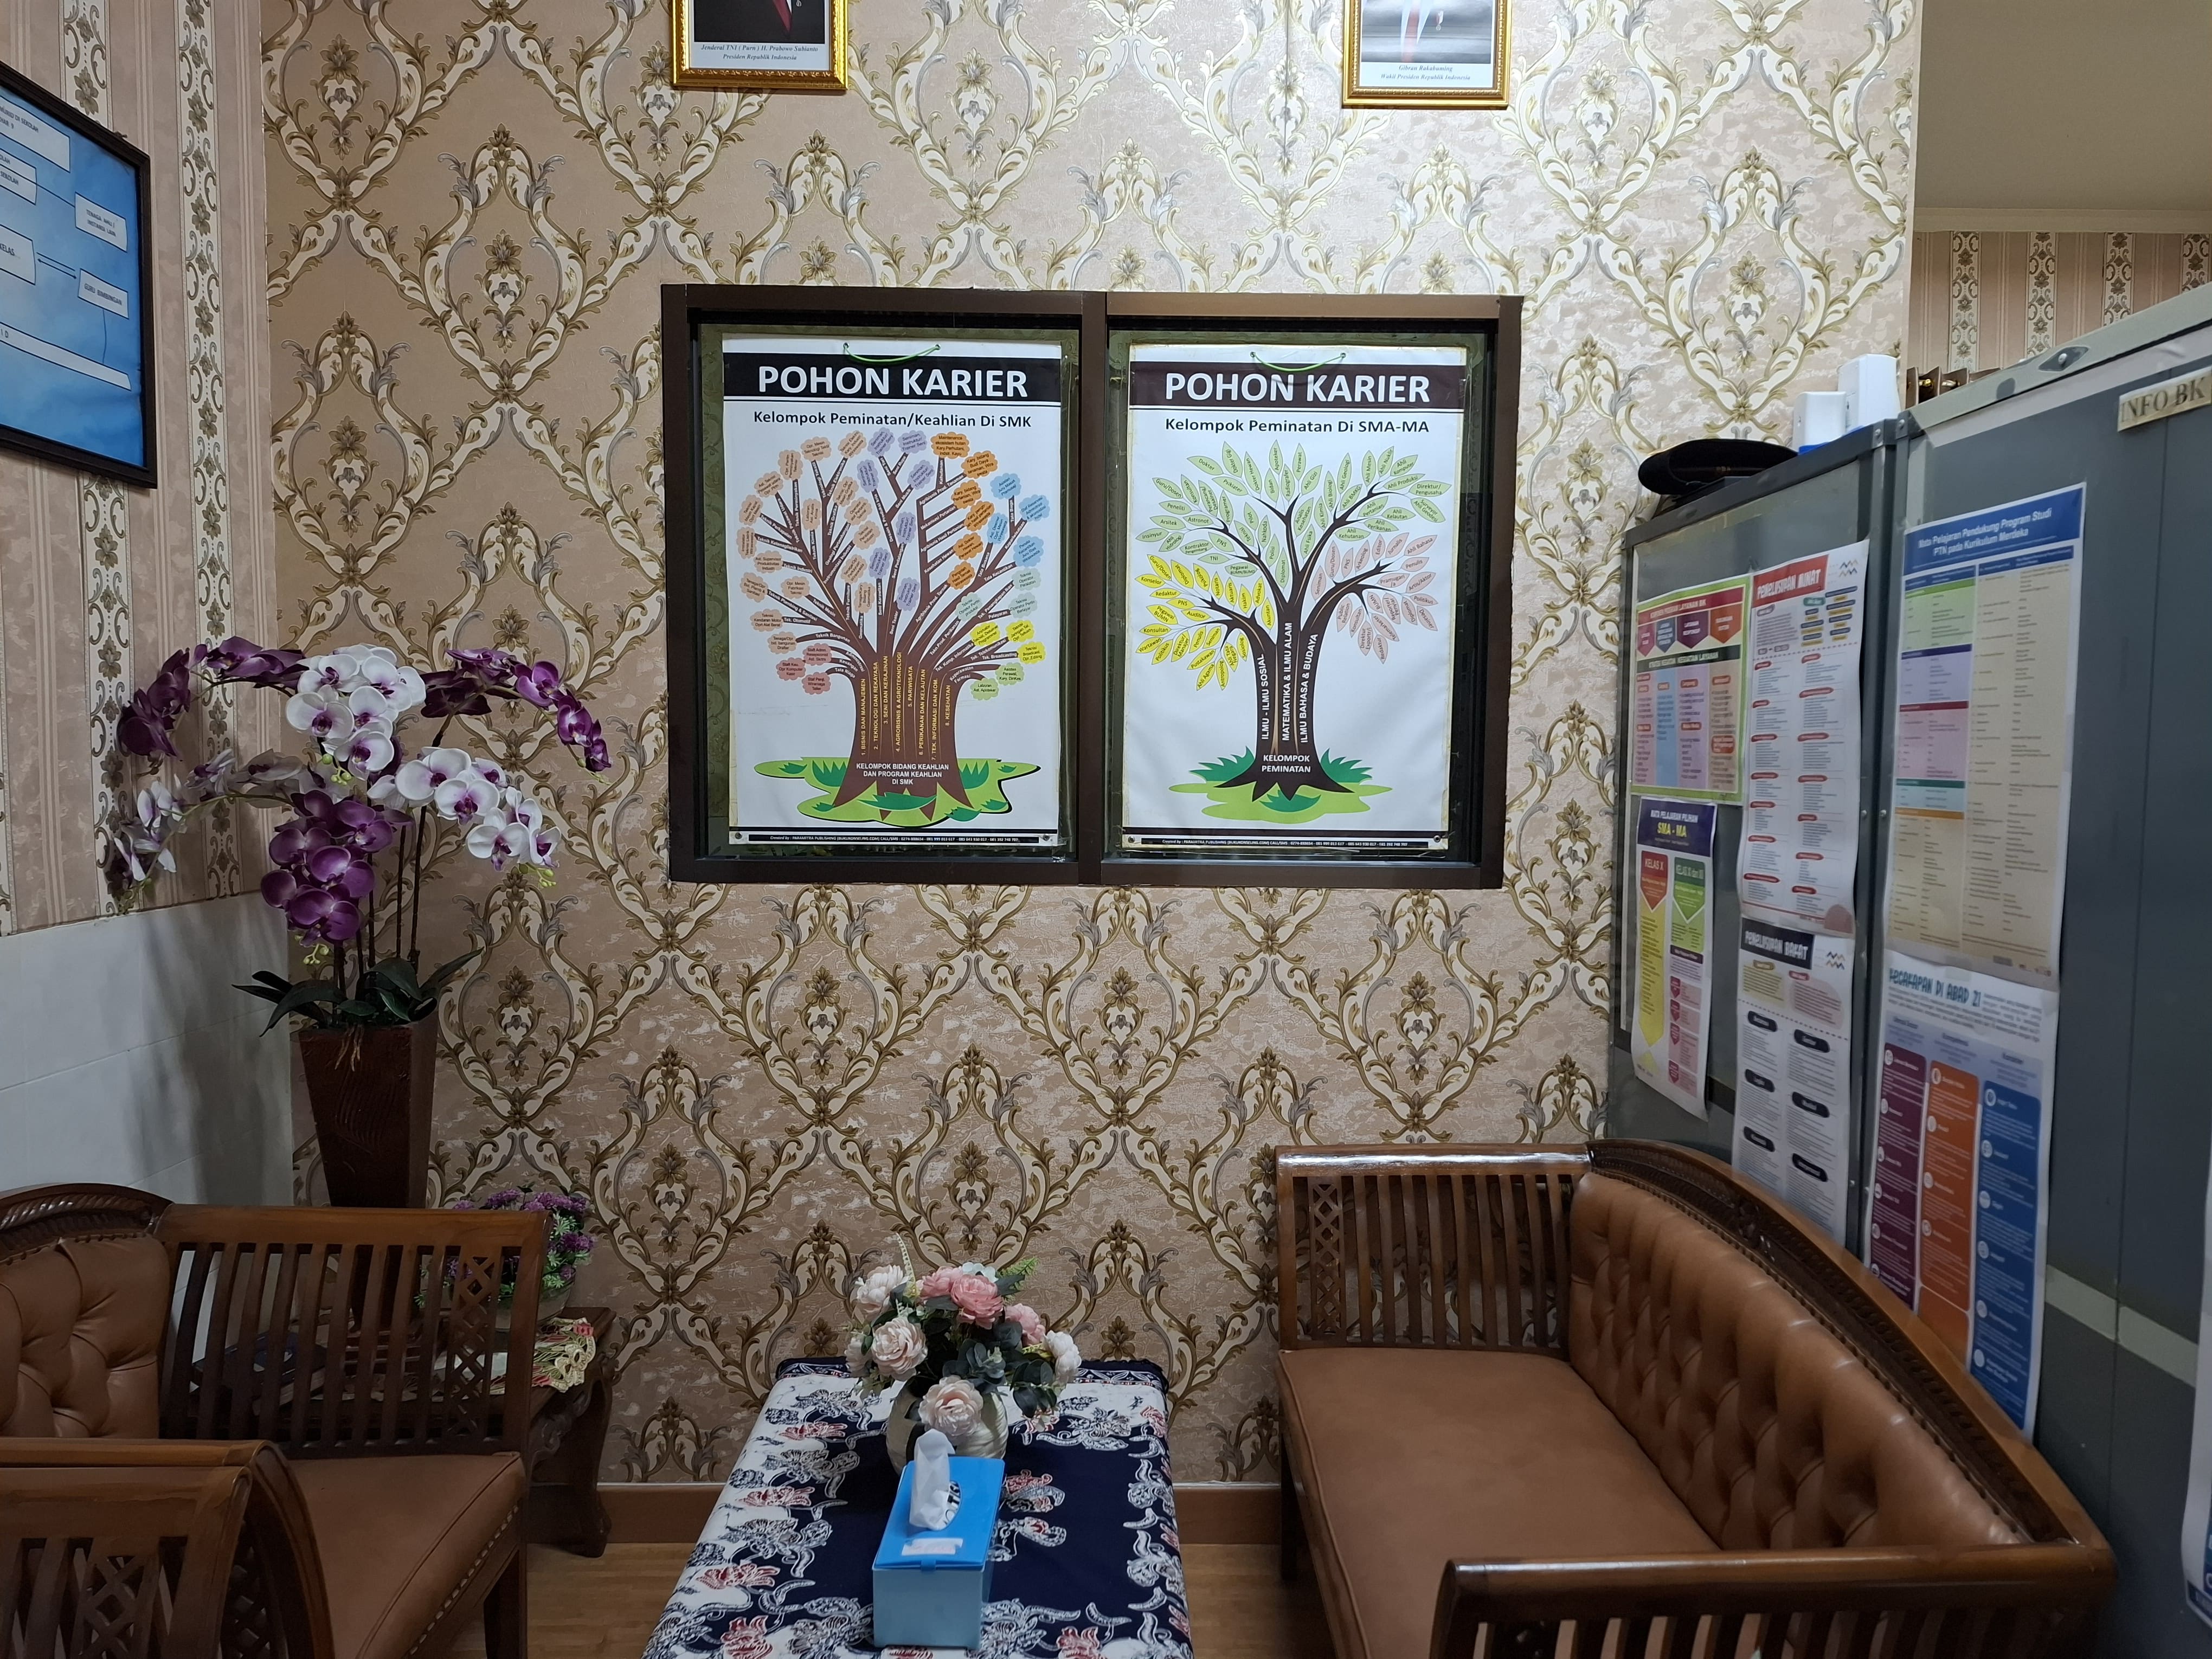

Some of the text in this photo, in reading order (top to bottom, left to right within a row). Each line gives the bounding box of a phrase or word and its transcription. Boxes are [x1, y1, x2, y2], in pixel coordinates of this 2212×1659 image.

[21, 118, 38, 132] SEKOLAH
[1, 171, 18, 185] SEKOLAH
[84, 283, 122, 305] GURU BIMBINGAN
[759, 366, 1028, 397] POHON KARIER
[1166, 372, 1430, 402] POHON KARIER
[2121, 377, 2205, 422] INFO BK
[754, 411, 1031, 427] Kelompok Peminatan/Keahlian Di SMK
[1166, 419, 1429, 433] Kelompok Peminatan Di SMA-MA
[1199, 459, 1214, 471] Dokter
[1156, 479, 1181, 498] Guru/Dosen
[1223, 479, 1243, 492] Psikiater
[1933, 532, 1961, 544] Pelajaran
[1962, 523, 1999, 536] Pendukung
[2001, 515, 2030, 528] Program
[2032, 507, 2052, 522] Studi
[1217, 538, 1227, 546] PNS
[1388, 539, 1403, 554] Jurnalis
[1933, 546, 1947, 556] PTN
[1964, 536, 1997, 548] Kurikulum
[1999, 528, 2028, 541] Merdeka
[1406, 559, 1423, 569] Penulis
[1141, 577, 1162, 585] Konselor
[1414, 596, 1433, 604] Politikus
[1187, 610, 1206, 619] Auditor
[1139, 638, 1161, 652] Wartawan
[1303, 634, 1318, 670] BUDAYA
[1257, 654, 1269, 687] SOSIAL
[1300, 681, 1309, 718] BAHASA
[1282, 683, 1290, 741] MATEMATIKA
[1300, 721, 1308, 743] ILMU
[1657, 822, 1671, 835] SMA
[1676, 825, 1687, 837] MA
[1935, 980, 1943, 998] DI
[1947, 983, 1969, 1003] ABAD
